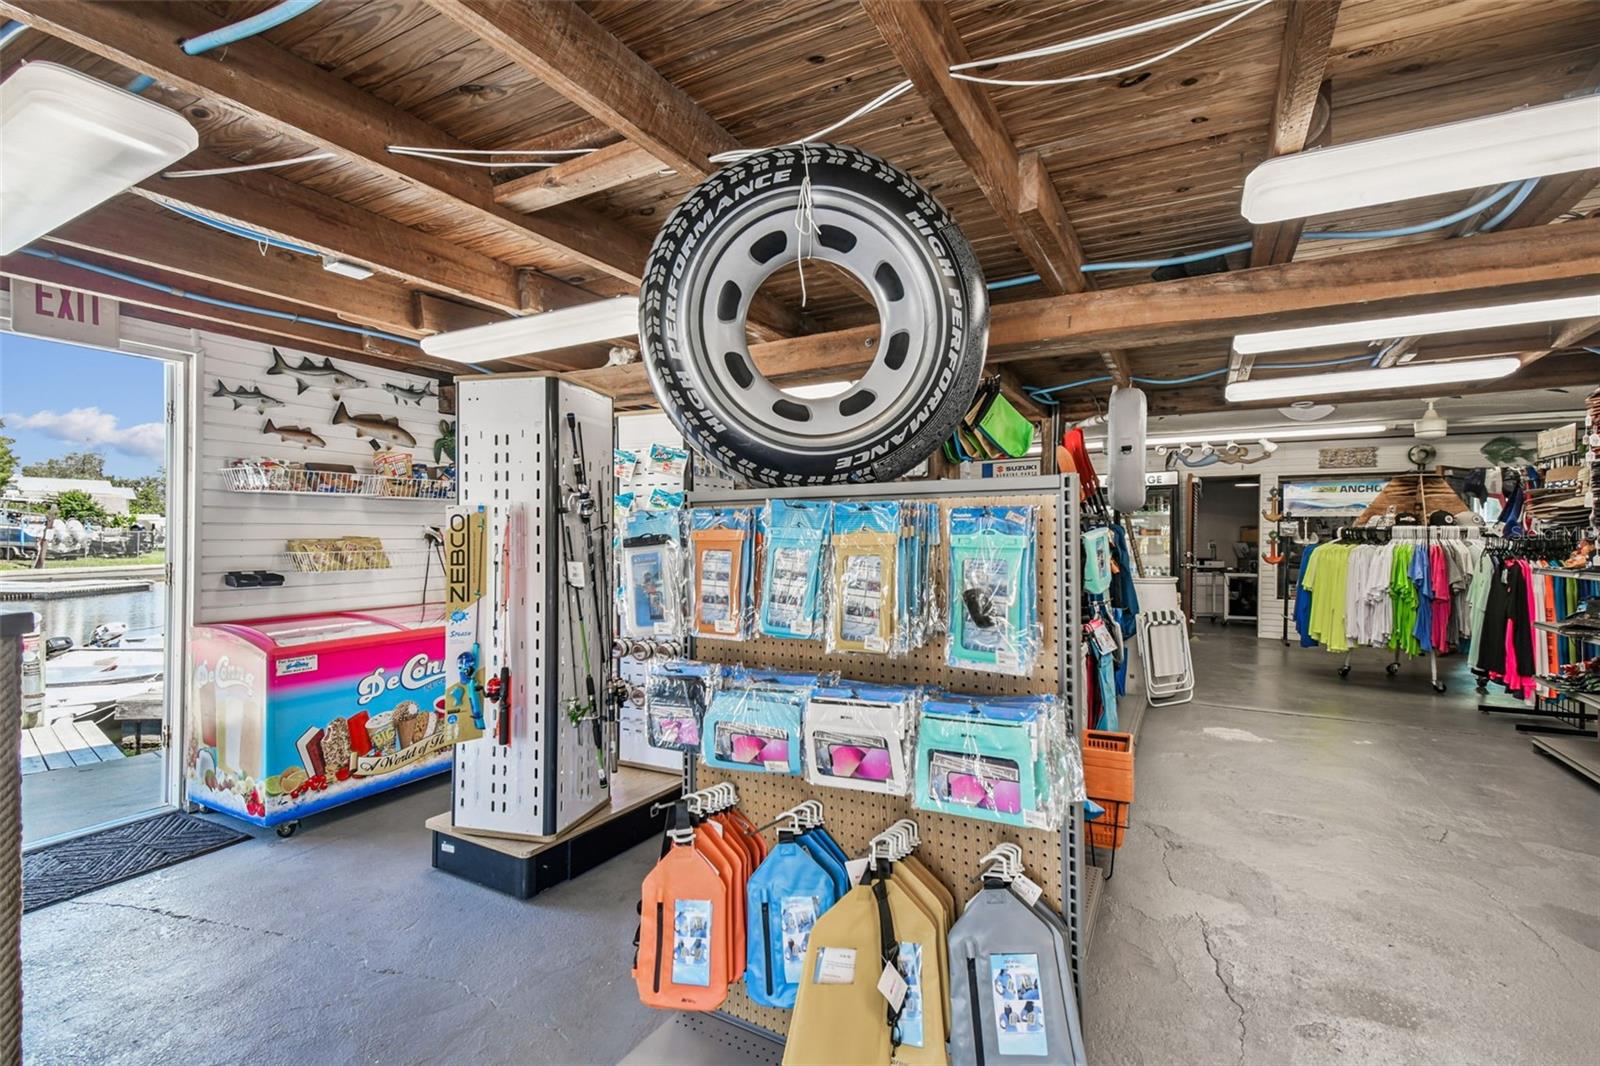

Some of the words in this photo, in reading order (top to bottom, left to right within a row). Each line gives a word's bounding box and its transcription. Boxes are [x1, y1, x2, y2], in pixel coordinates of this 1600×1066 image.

[665, 169, 792, 361] PERFORMANCE
[905, 210, 956, 277] HIGH
[676, 371, 727, 433] HIGH
[834, 287, 963, 470] PERFORMANCE
[1005, 464, 1037, 472] SUZUKI
[450, 513, 465, 603] ZEBCO
[373, 727, 396, 747] BIG
[380, 746, 418, 769] World
[417, 742, 429, 757] of
